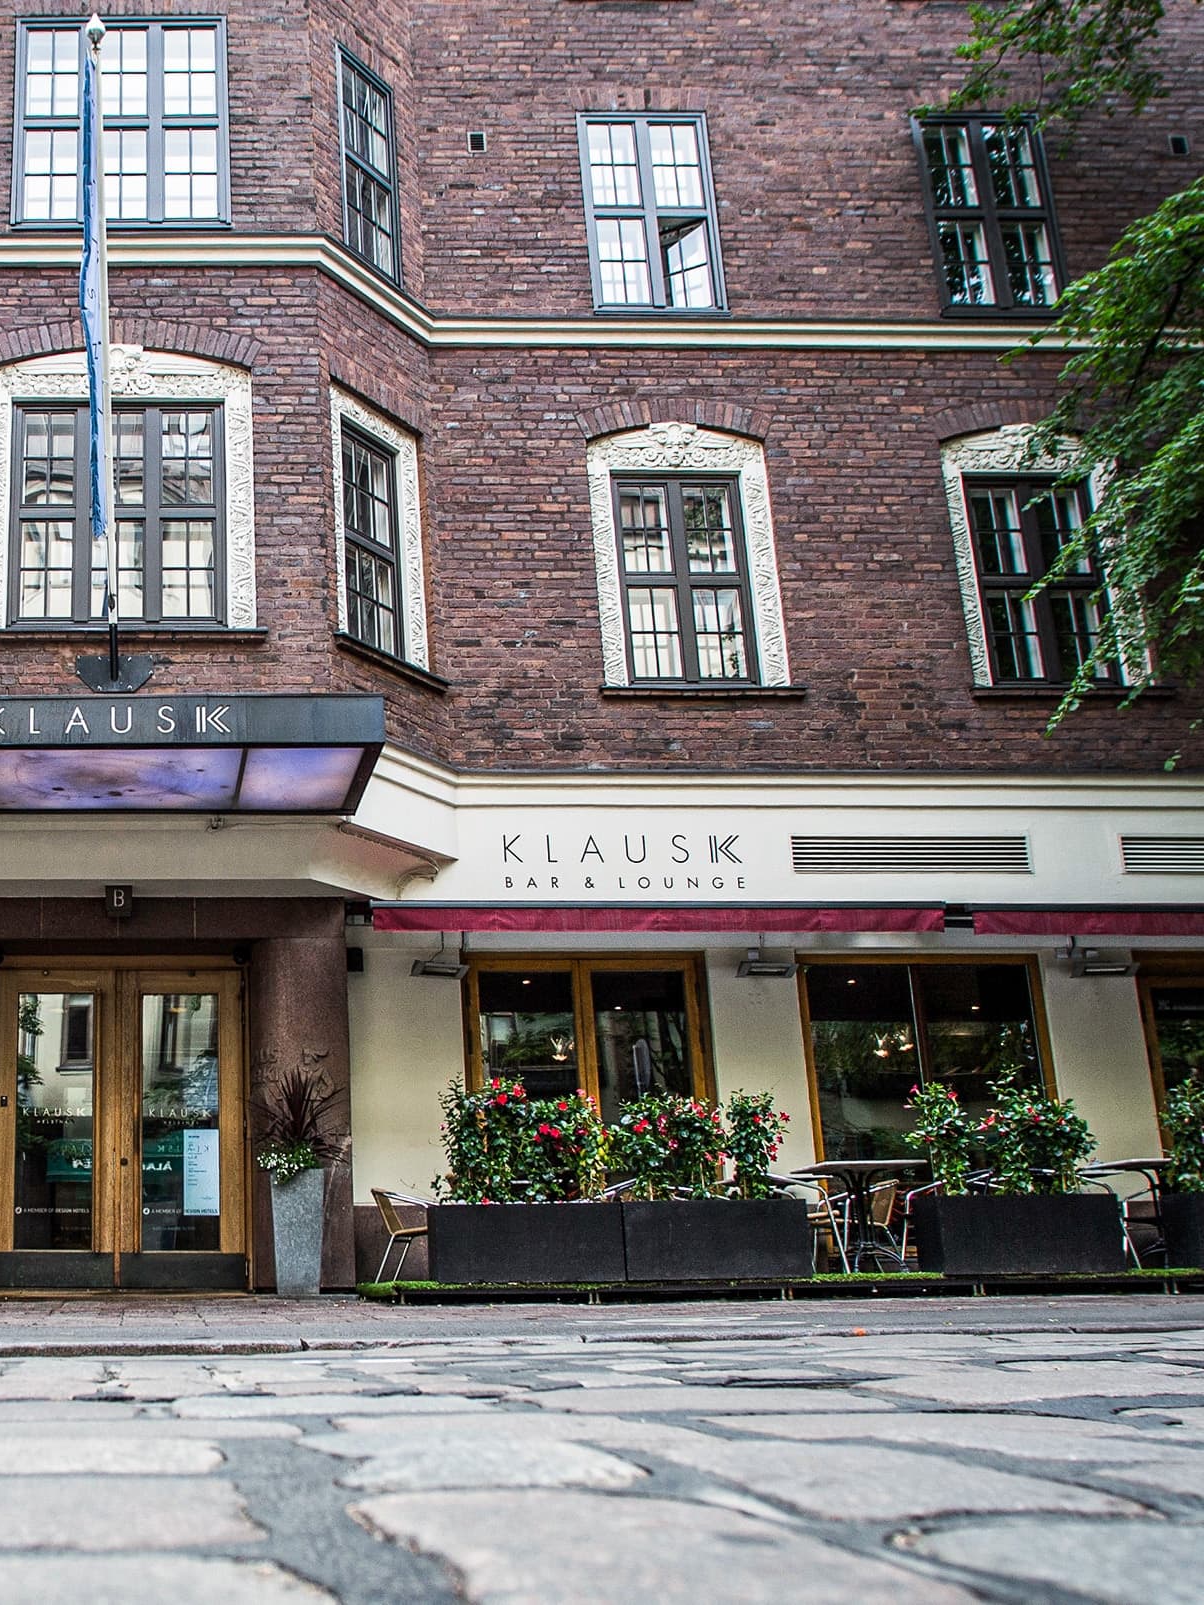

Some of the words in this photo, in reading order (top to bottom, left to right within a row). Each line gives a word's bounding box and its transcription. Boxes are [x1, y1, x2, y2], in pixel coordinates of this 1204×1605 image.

[504, 876, 559, 889] BAR
[584, 876, 595, 889] &
[618, 876, 746, 889] LOUNGE
[113, 889, 125, 907] B
